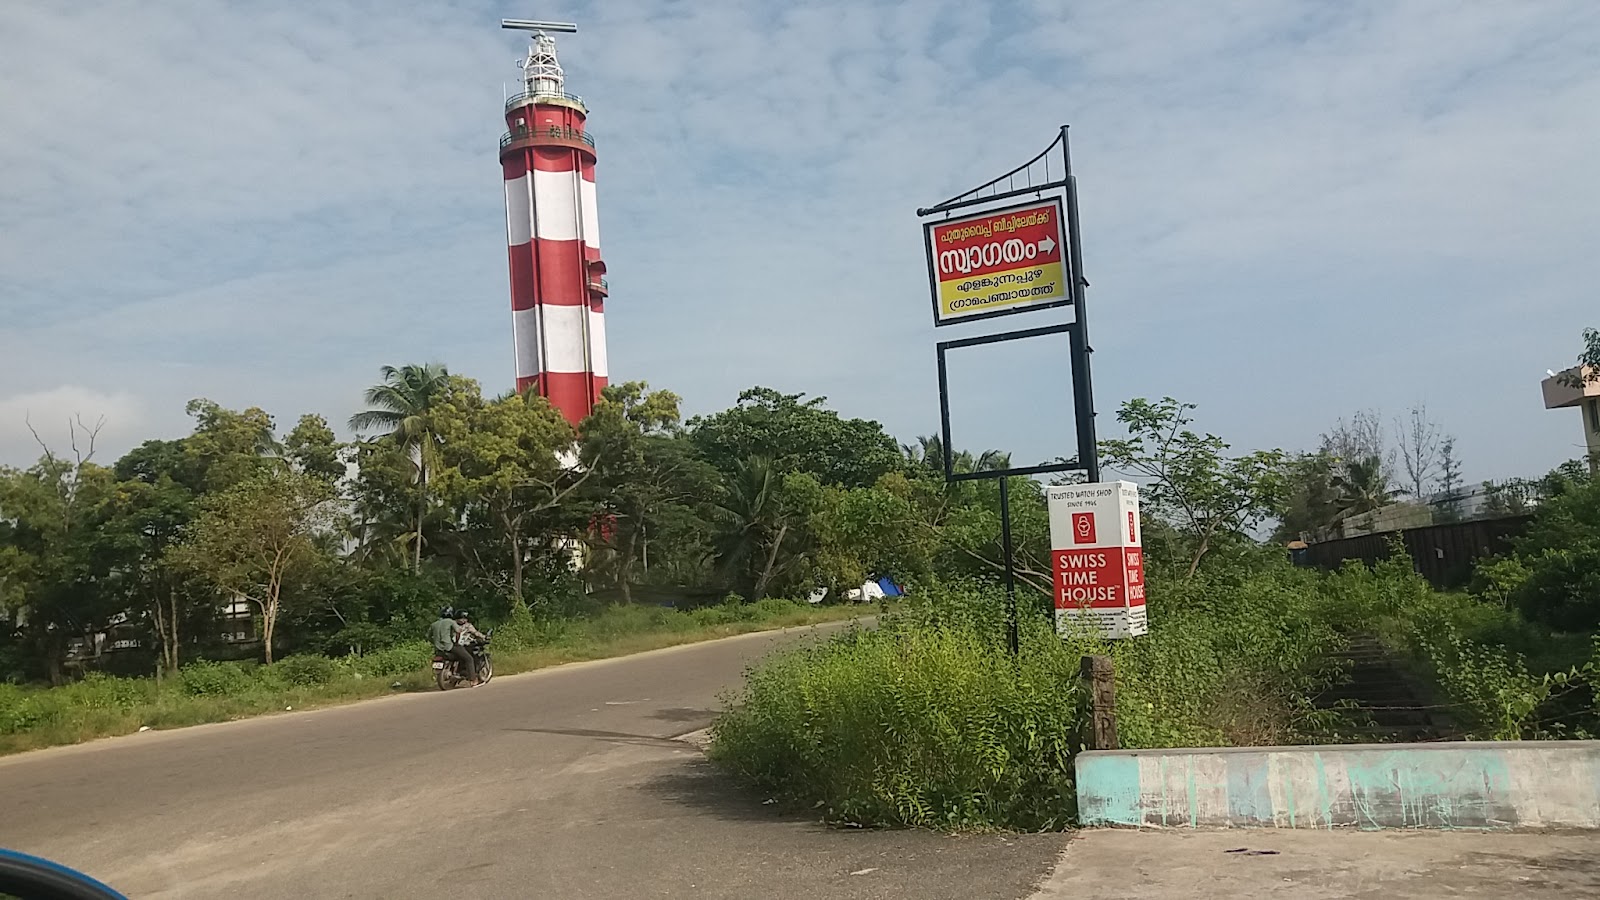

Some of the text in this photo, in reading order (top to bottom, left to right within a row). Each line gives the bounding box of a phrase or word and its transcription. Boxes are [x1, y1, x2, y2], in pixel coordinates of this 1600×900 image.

[940, 238, 1037, 274] സ്വാഗതം
[957, 269, 1043, 292] എളങ്കുന്നപ്പുഴ
[950, 282, 1055, 311] ഗ്രാമപഞ്ചായത്ത്
[1051, 491, 1075, 500] TRUSTED
[1075, 489, 1095, 498] WATCH
[1096, 488, 1112, 497] SHOP
[1059, 553, 1107, 569] SWISS
[1126, 552, 1139, 567] SWISS
[1060, 571, 1098, 586] TIME
[1128, 569, 1139, 583] TIME
